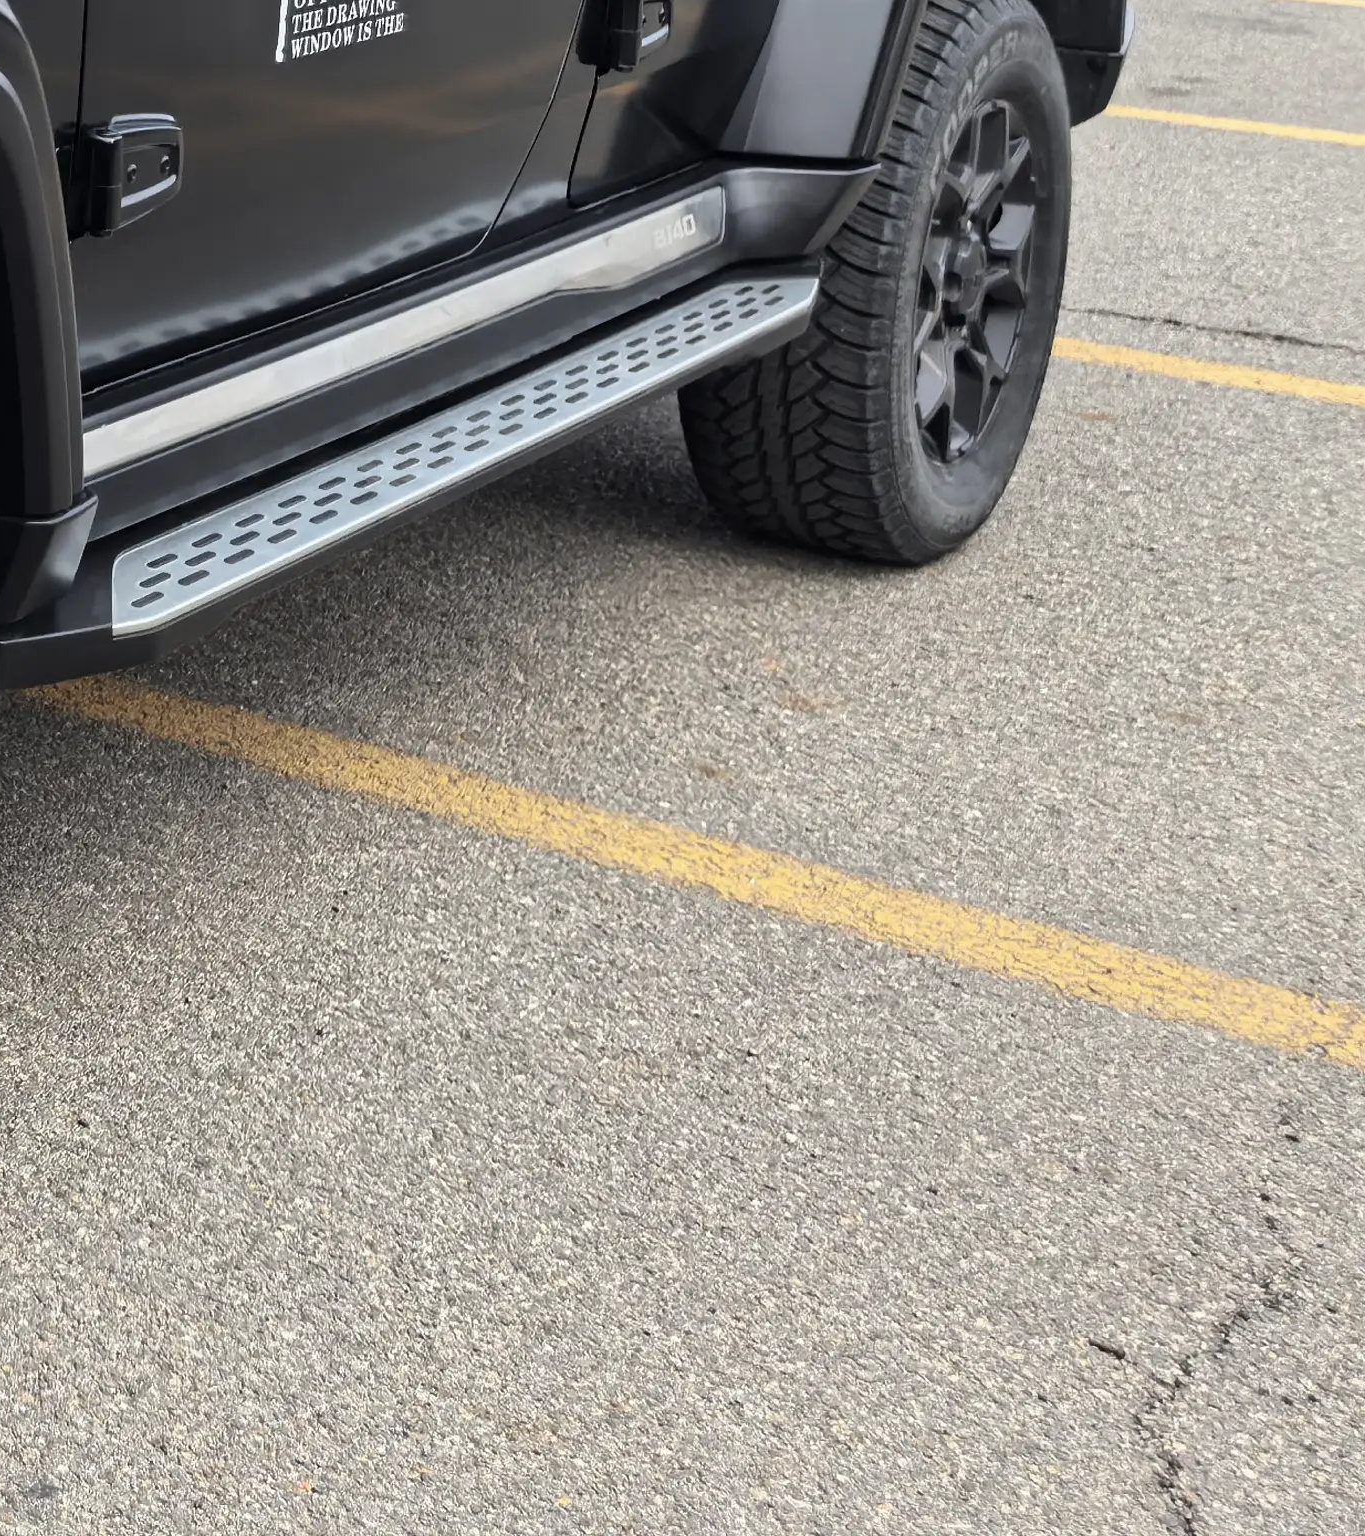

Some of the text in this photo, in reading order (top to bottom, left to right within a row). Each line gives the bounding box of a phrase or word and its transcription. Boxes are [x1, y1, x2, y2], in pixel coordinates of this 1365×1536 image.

[291, 10, 323, 34] THE
[291, 12, 405, 59] WINDOW IS THE
